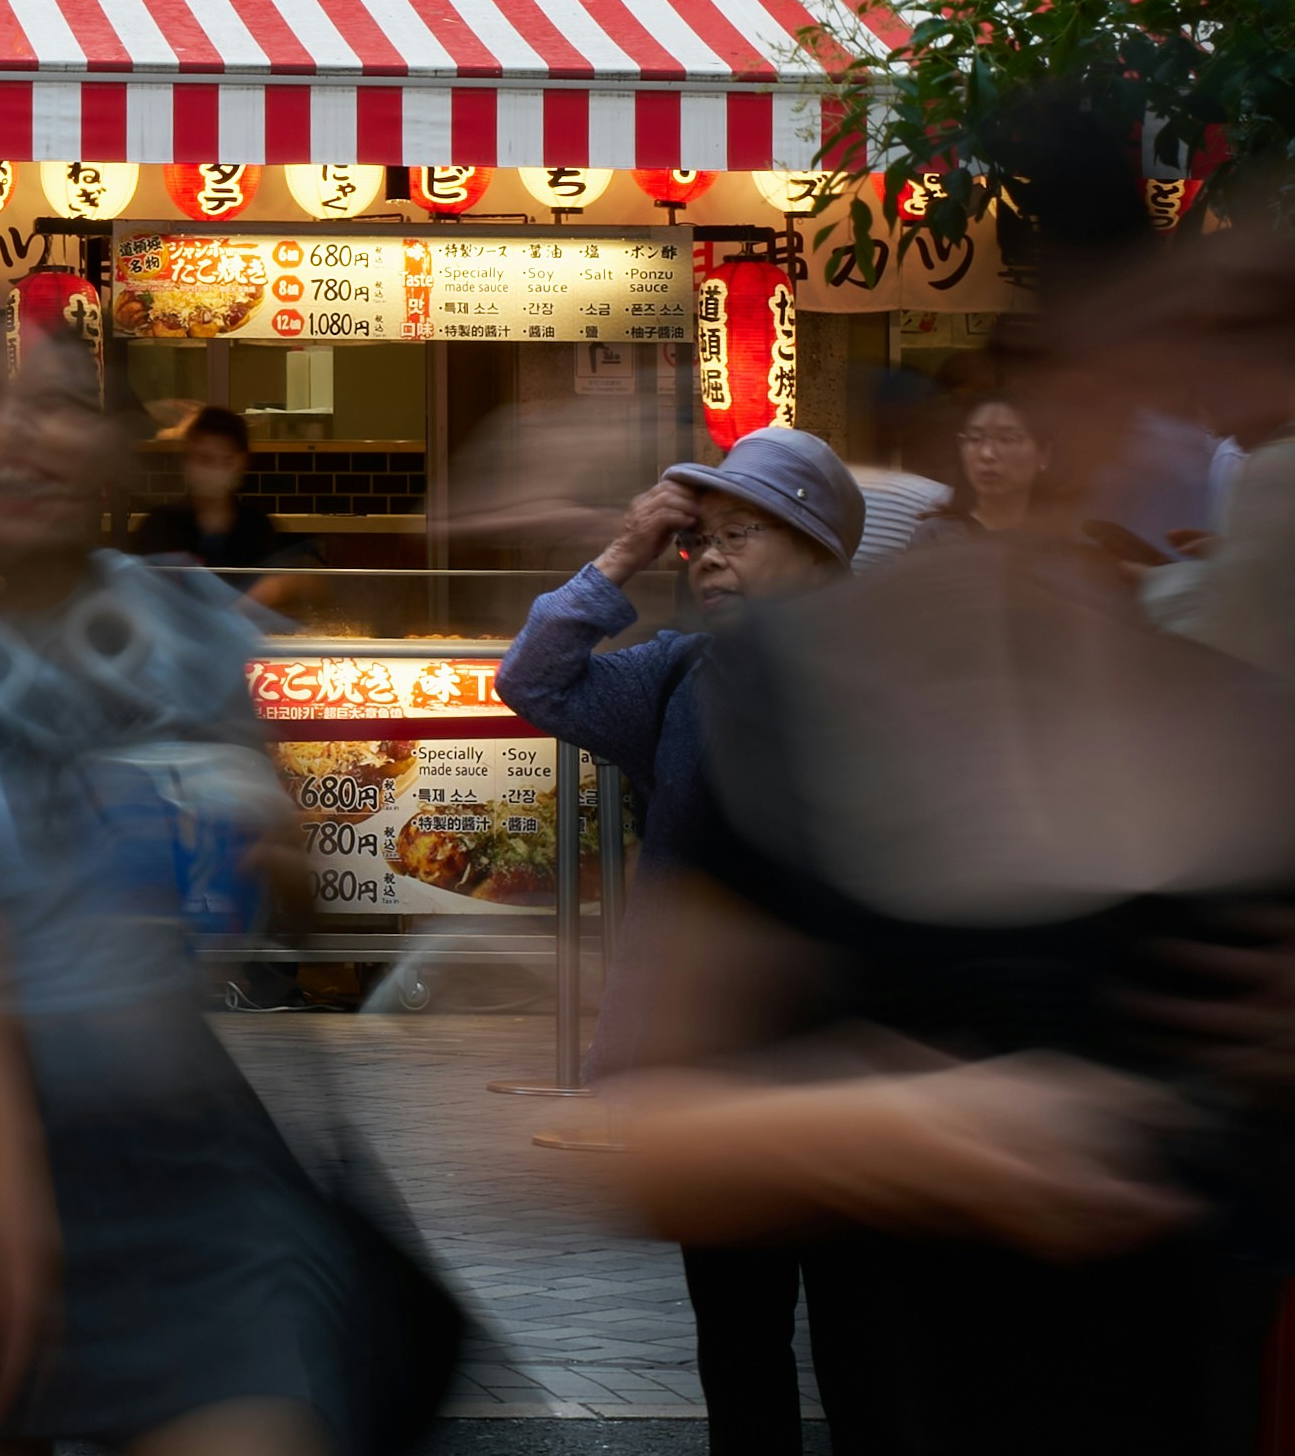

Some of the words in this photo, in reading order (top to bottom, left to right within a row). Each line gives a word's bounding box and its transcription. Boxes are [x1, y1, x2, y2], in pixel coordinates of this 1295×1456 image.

[67, 163, 106, 218] ねぎ
[310, 244, 369, 268] 680円
[129, 256, 161, 274] 名物
[170, 254, 269, 286] たこ焼き
[400, 270, 435, 288] Taste
[444, 267, 505, 282] Specially
[527, 267, 554, 282] Soy
[584, 268, 614, 282] Salt
[629, 268, 674, 281] Ponzu
[310, 278, 370, 303] 780円
[444, 281, 476, 294] made
[478, 283, 509, 294] sauce
[527, 282, 568, 294] sauce
[629, 282, 669, 294] sauce
[473, 302, 500, 316] 소스
[528, 301, 555, 316] 간장
[585, 302, 611, 317] 소금
[308, 312, 370, 337] 1,080円
[247, 658, 399, 704] たこ焼き
[418, 746, 484, 765] Specially
[507, 747, 538, 765] Soy
[418, 763, 452, 777] made
[455, 765, 489, 777] sauce
[507, 765, 552, 778] sauce
[300, 776, 379, 812] 680円
[418, 788, 446, 804] 특제
[449, 789, 478, 804] 소스
[507, 788, 537, 804] 간장
[301, 822, 379, 858] 780円
